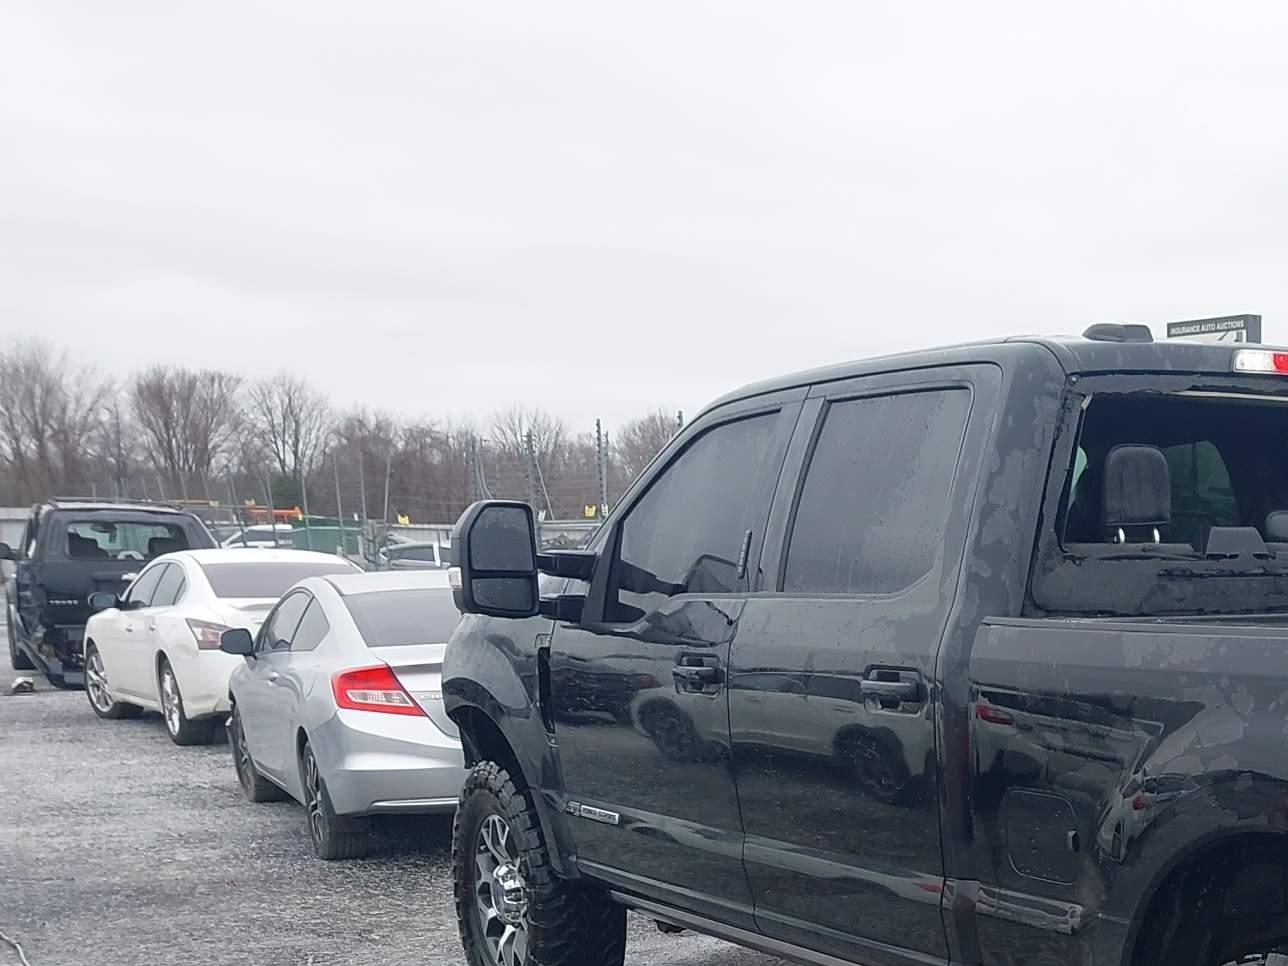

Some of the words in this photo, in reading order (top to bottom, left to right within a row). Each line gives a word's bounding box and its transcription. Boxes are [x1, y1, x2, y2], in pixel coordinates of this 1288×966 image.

[1170, 325, 1200, 335] INSURANCE
[1201, 322, 1216, 332] AUTO
[1216, 320, 1244, 330] AUCTIONS
